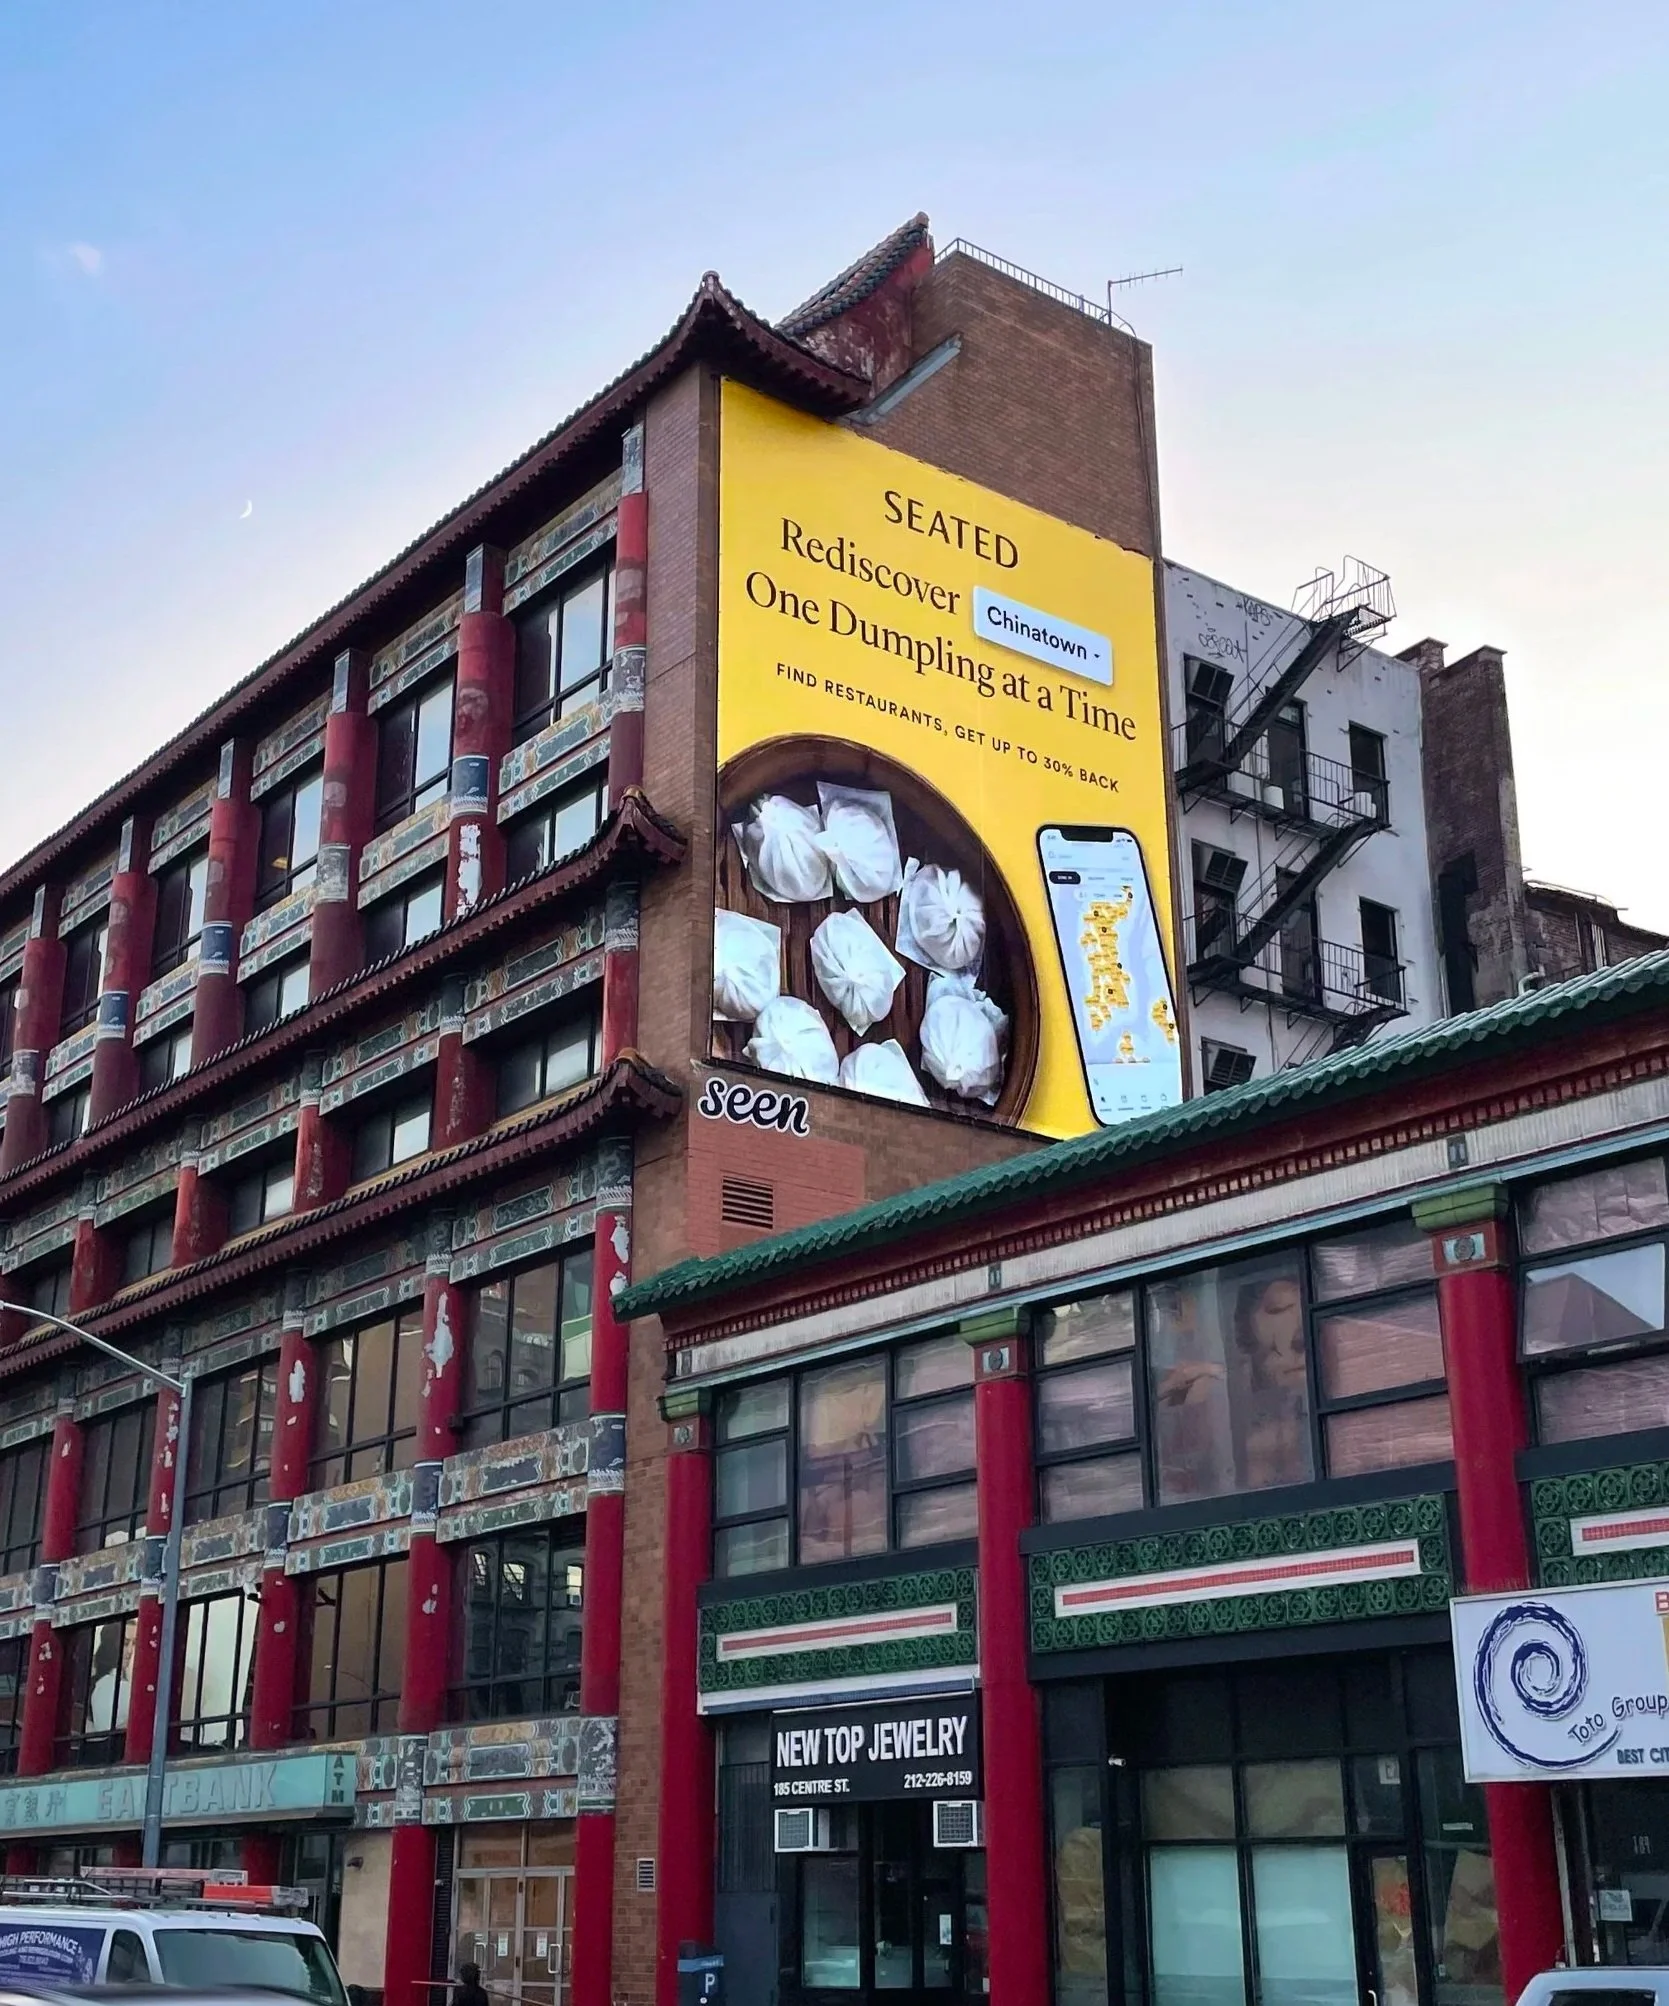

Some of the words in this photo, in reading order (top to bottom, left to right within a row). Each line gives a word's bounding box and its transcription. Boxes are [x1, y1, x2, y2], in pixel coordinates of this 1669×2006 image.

[884, 490, 1018, 569] SEATED
[780, 518, 961, 615] Rediscover
[987, 606, 1088, 660] Chinatown
[746, 571, 820, 625] One
[829, 599, 995, 697] Dumpling
[1002, 672, 1031, 703] at
[1037, 685, 1054, 712] a
[1059, 684, 1136, 741] Time
[777, 663, 817, 688] FIND
[825, 680, 948, 736] RESTAURANTS,
[955, 725, 986, 746] GET
[992, 737, 1011, 755] UP
[1017, 746, 1037, 764] TO
[1043, 756, 1073, 778] 30%
[1080, 768, 1119, 793] BACK
[698, 1077, 810, 1137] seen
[776, 1729, 820, 1768] NEW
[824, 1725, 865, 1764] TOP
[868, 1715, 967, 1761] JEWELRY
[1567, 1713, 1605, 1744] Toto
[1611, 1694, 1669, 1719] Group
[332, 1754, 346, 1804] ATM
[904, 1770, 972, 1789] 212-226-8159
[1617, 1748, 1644, 1764] BEST
[97, 1763, 277, 1820] EATBANK
[774, 1782, 790, 1796] 185
[791, 1779, 832, 1794] CENTRE
[834, 1778, 850, 1793] ST.
[20, 1931, 79, 1956] PERFORMANCE
